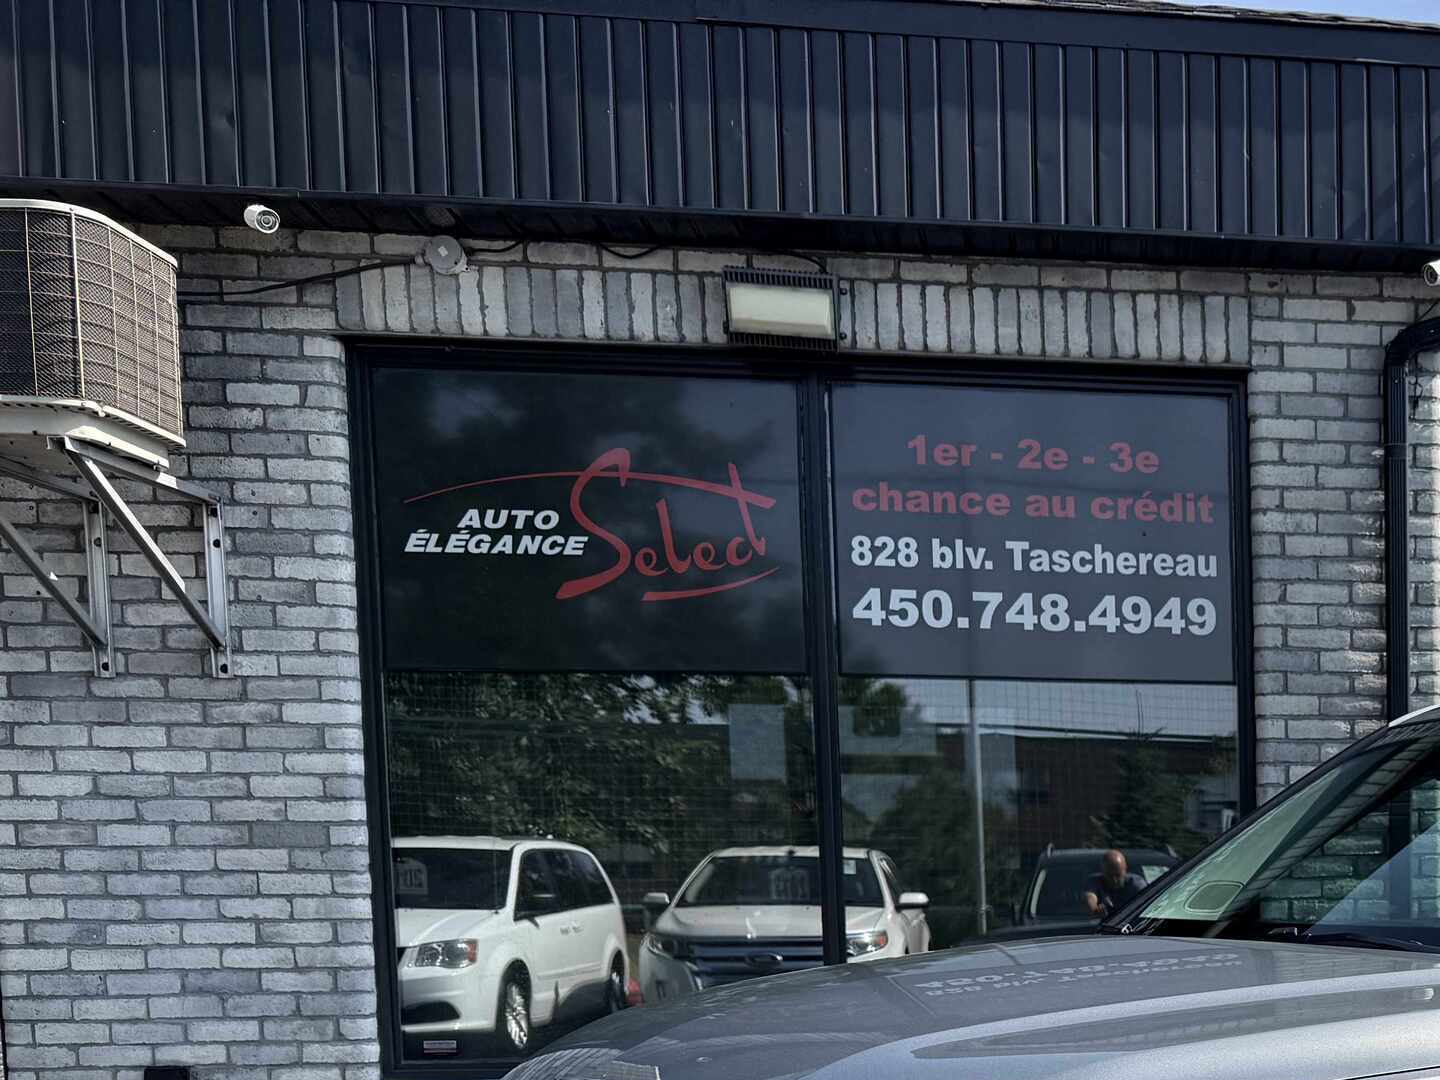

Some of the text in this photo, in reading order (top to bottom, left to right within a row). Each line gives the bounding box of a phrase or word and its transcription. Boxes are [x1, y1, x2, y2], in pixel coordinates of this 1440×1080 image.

[907, 434, 977, 466] 1er
[1017, 439, 1069, 471] 2e
[1109, 442, 1160, 474] 3e
[457, 508, 560, 530] AUTO
[556, 448, 777, 600] Select
[851, 481, 1214, 524] chance au crédit
[404, 529, 589, 557] ÉLÉGANCE
[850, 535, 1218, 578] 828 blv. Taschereau
[852, 587, 1217, 637] 450.748.4949
